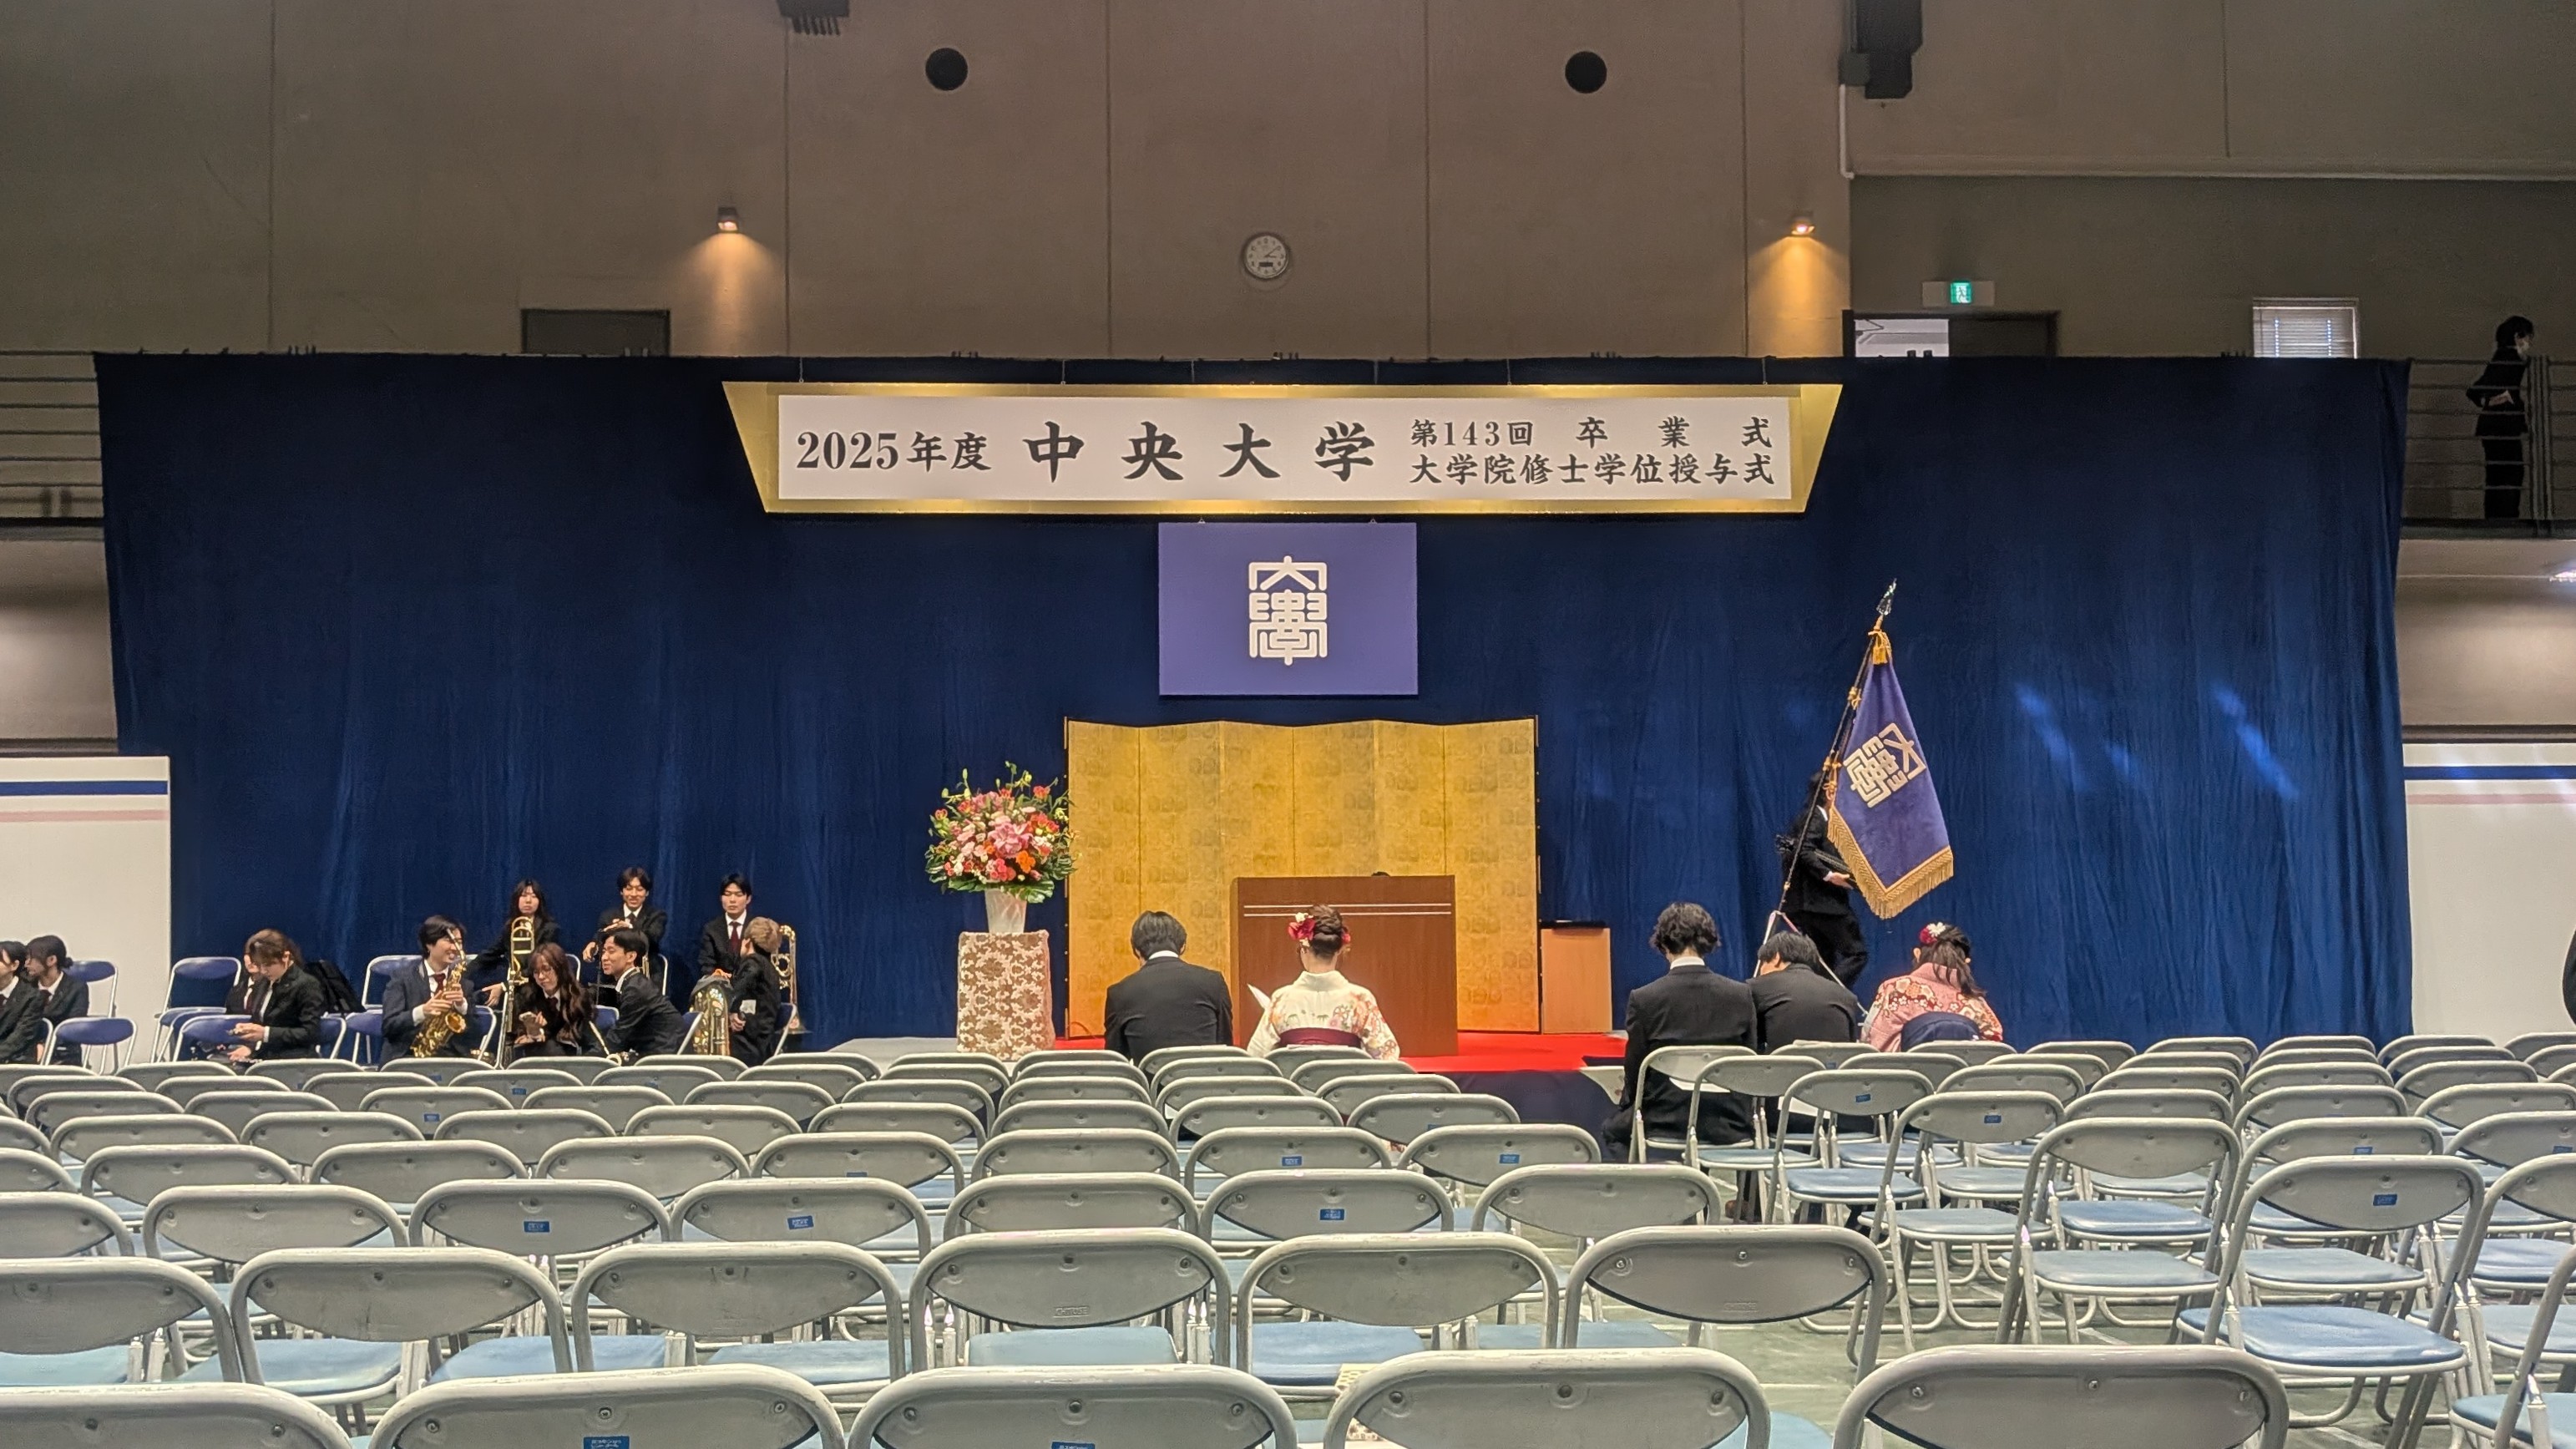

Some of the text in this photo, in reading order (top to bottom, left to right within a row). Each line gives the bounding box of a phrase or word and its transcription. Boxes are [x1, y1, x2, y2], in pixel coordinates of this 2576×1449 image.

[1410, 416, 1774, 449] 第143回 卒業式
[796, 421, 1376, 484] 2025年度 中央大学
[1409, 453, 1775, 485] 大学院修士学位授与式
